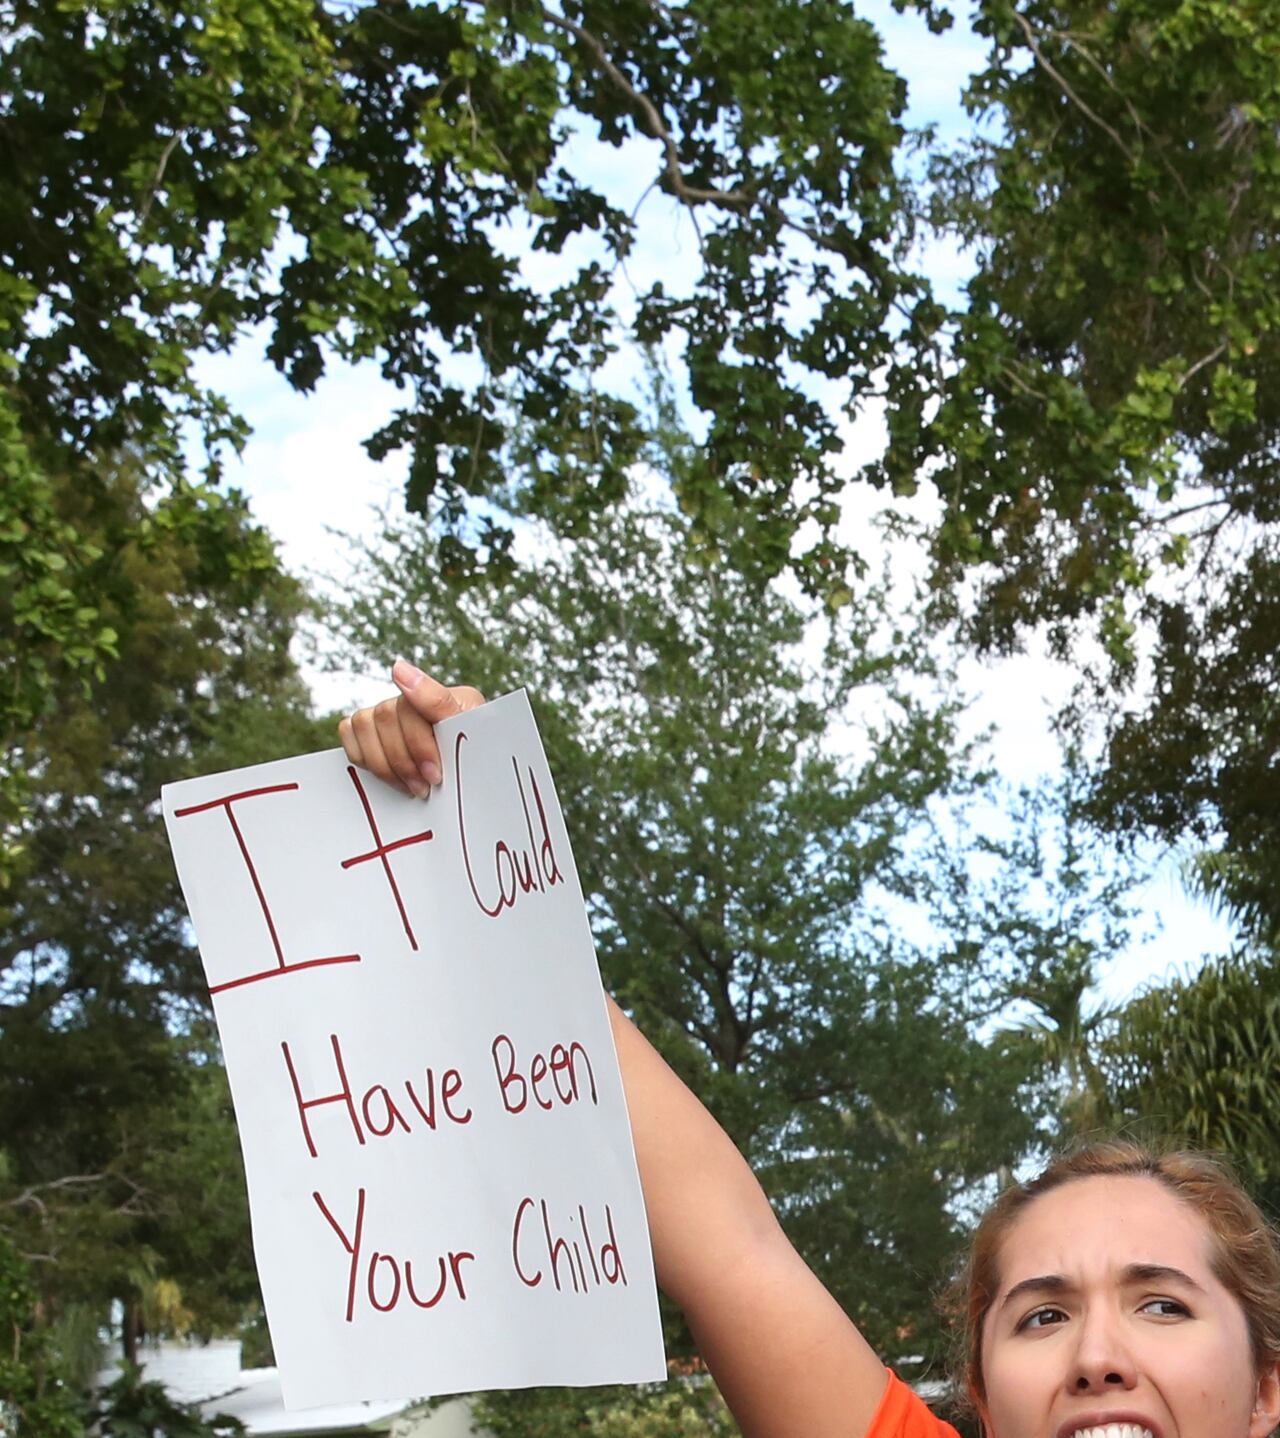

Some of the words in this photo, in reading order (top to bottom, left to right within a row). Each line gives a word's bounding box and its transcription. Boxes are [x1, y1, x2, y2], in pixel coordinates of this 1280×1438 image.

[174, 764, 433, 994] It
[455, 731, 564, 917] Could
[281, 1033, 473, 1158] Have
[491, 1033, 599, 1114] Been
[313, 1188, 474, 1323] Your
[512, 1196, 627, 1293] Child
